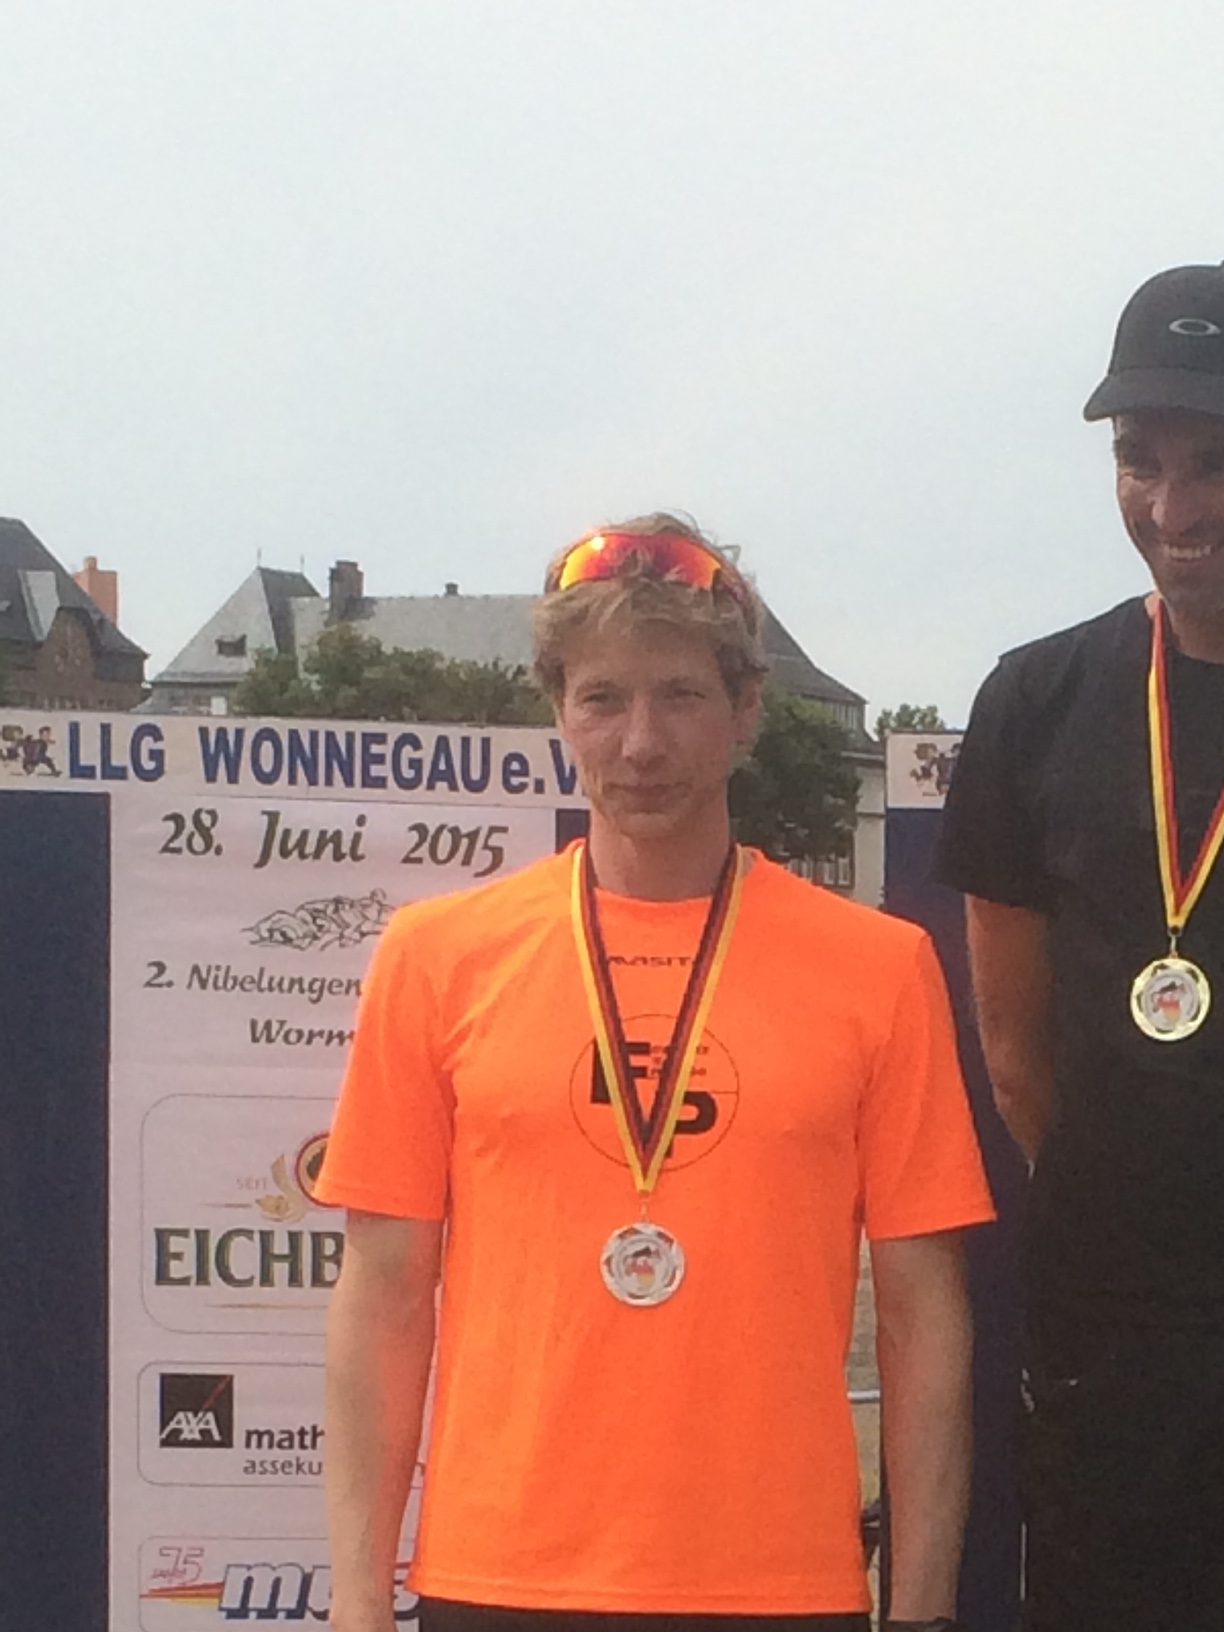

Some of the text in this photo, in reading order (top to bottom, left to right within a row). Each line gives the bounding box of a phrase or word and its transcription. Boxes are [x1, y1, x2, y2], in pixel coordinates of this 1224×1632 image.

[68, 721, 165, 783] LLG
[199, 726, 491, 793] WONNEGAU
[159, 807, 509, 877] 28. Juni 2015
[143, 961, 362, 1004] 2. Nibelungen
[249, 1018, 356, 1047] Worm
[154, 1228, 345, 1288] EICHB
[160, 1410, 221, 1441] AXA
[243, 1456, 323, 1477] asseku
